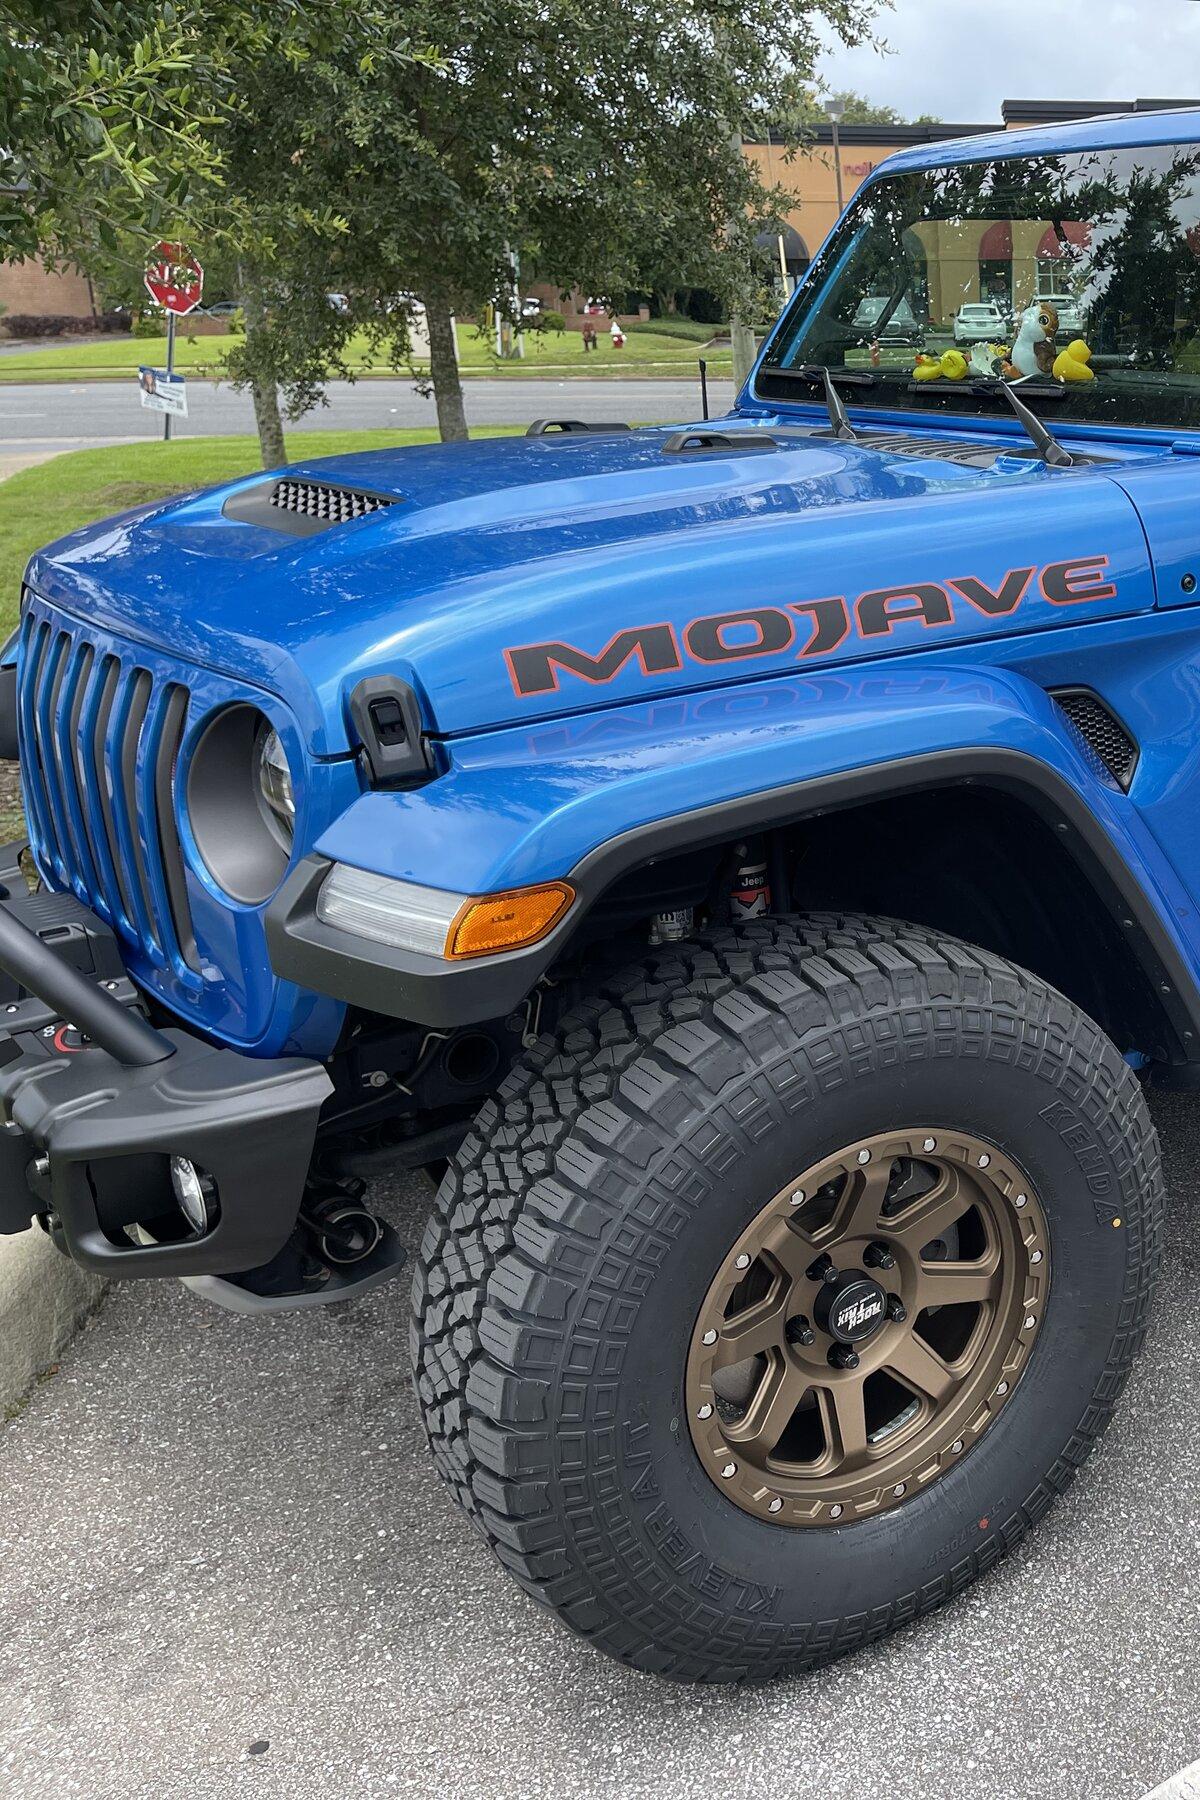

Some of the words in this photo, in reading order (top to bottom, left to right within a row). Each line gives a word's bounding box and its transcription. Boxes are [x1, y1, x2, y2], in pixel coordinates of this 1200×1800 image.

[503, 554, 1117, 698] MOJAVE
[741, 876, 764, 887] Jeep
[1038, 1099, 1121, 1225] KENDA
[643, 1501, 785, 1616] KLEVER
